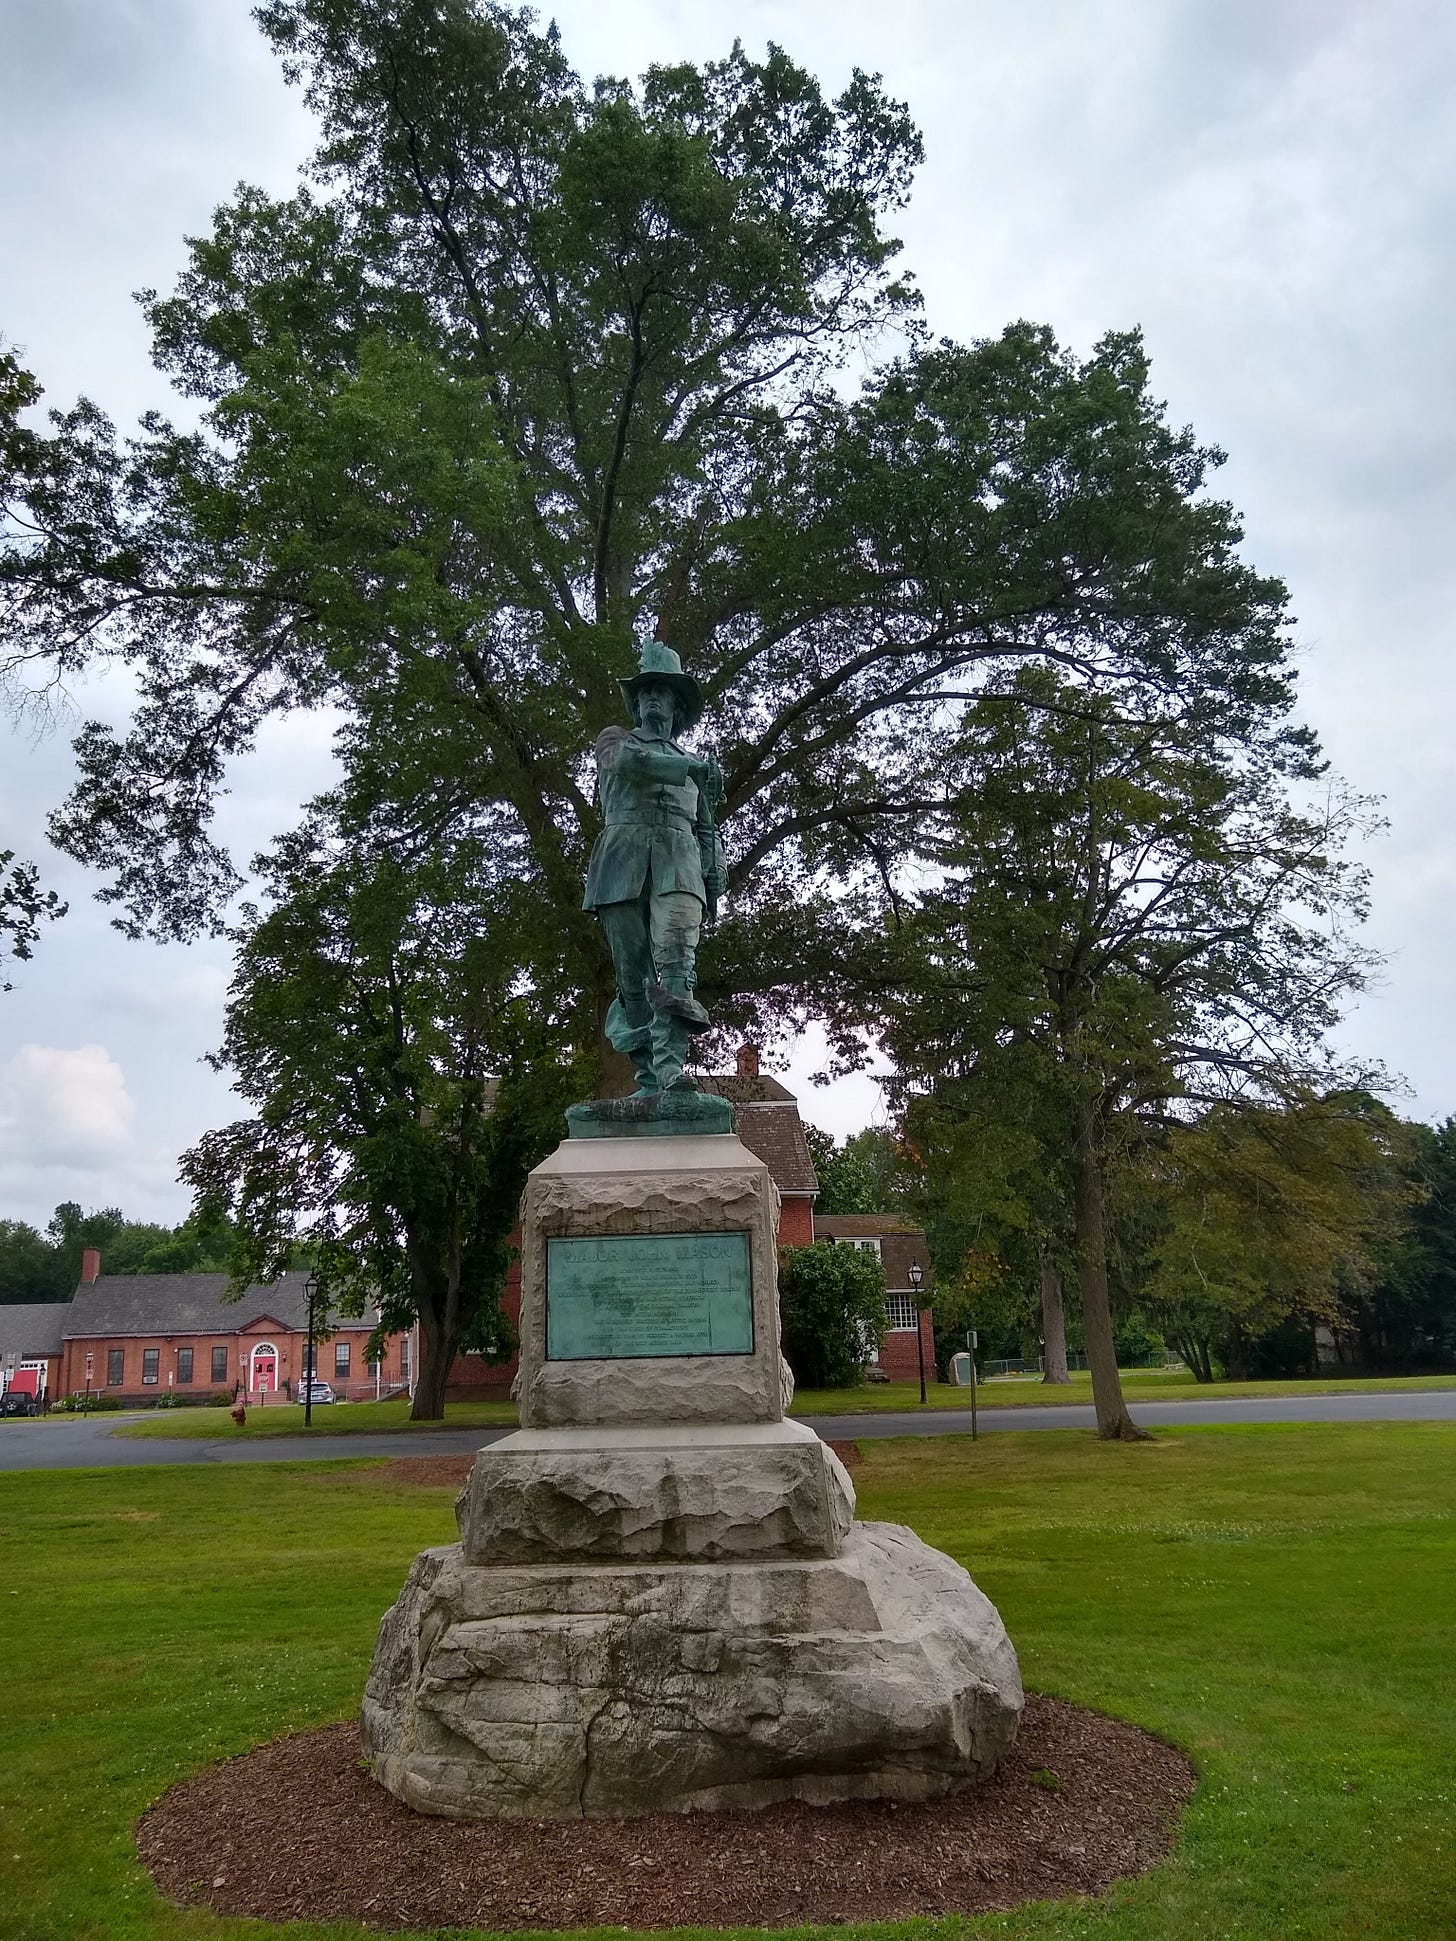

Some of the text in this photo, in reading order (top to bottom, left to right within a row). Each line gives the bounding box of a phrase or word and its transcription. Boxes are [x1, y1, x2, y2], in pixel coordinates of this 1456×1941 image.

[565, 1244, 732, 1263] MAJOR JOHN MASON
